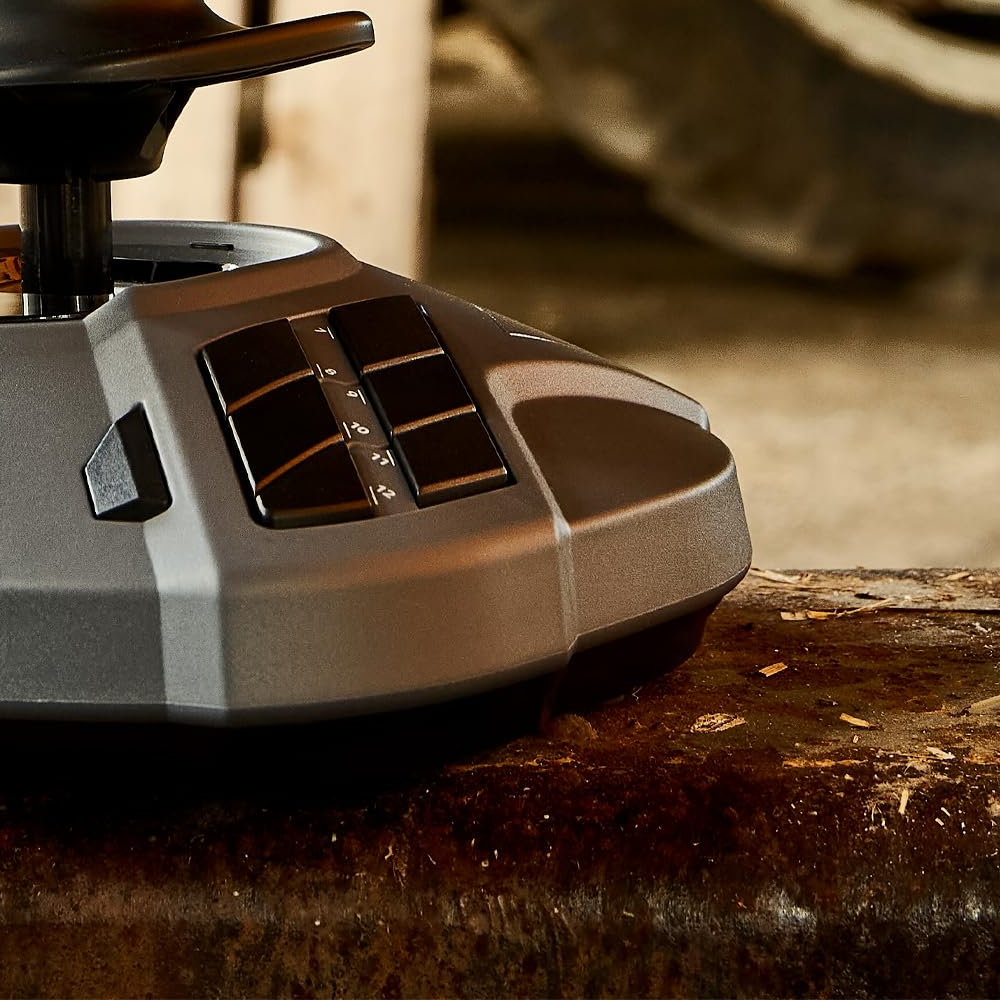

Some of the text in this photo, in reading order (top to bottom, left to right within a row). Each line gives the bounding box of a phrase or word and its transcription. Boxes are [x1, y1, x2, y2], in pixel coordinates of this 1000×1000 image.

[346, 390, 359, 398] 9
[350, 421, 370, 435] 10
[371, 452, 390, 466] 11
[376, 484, 397, 500] 12
